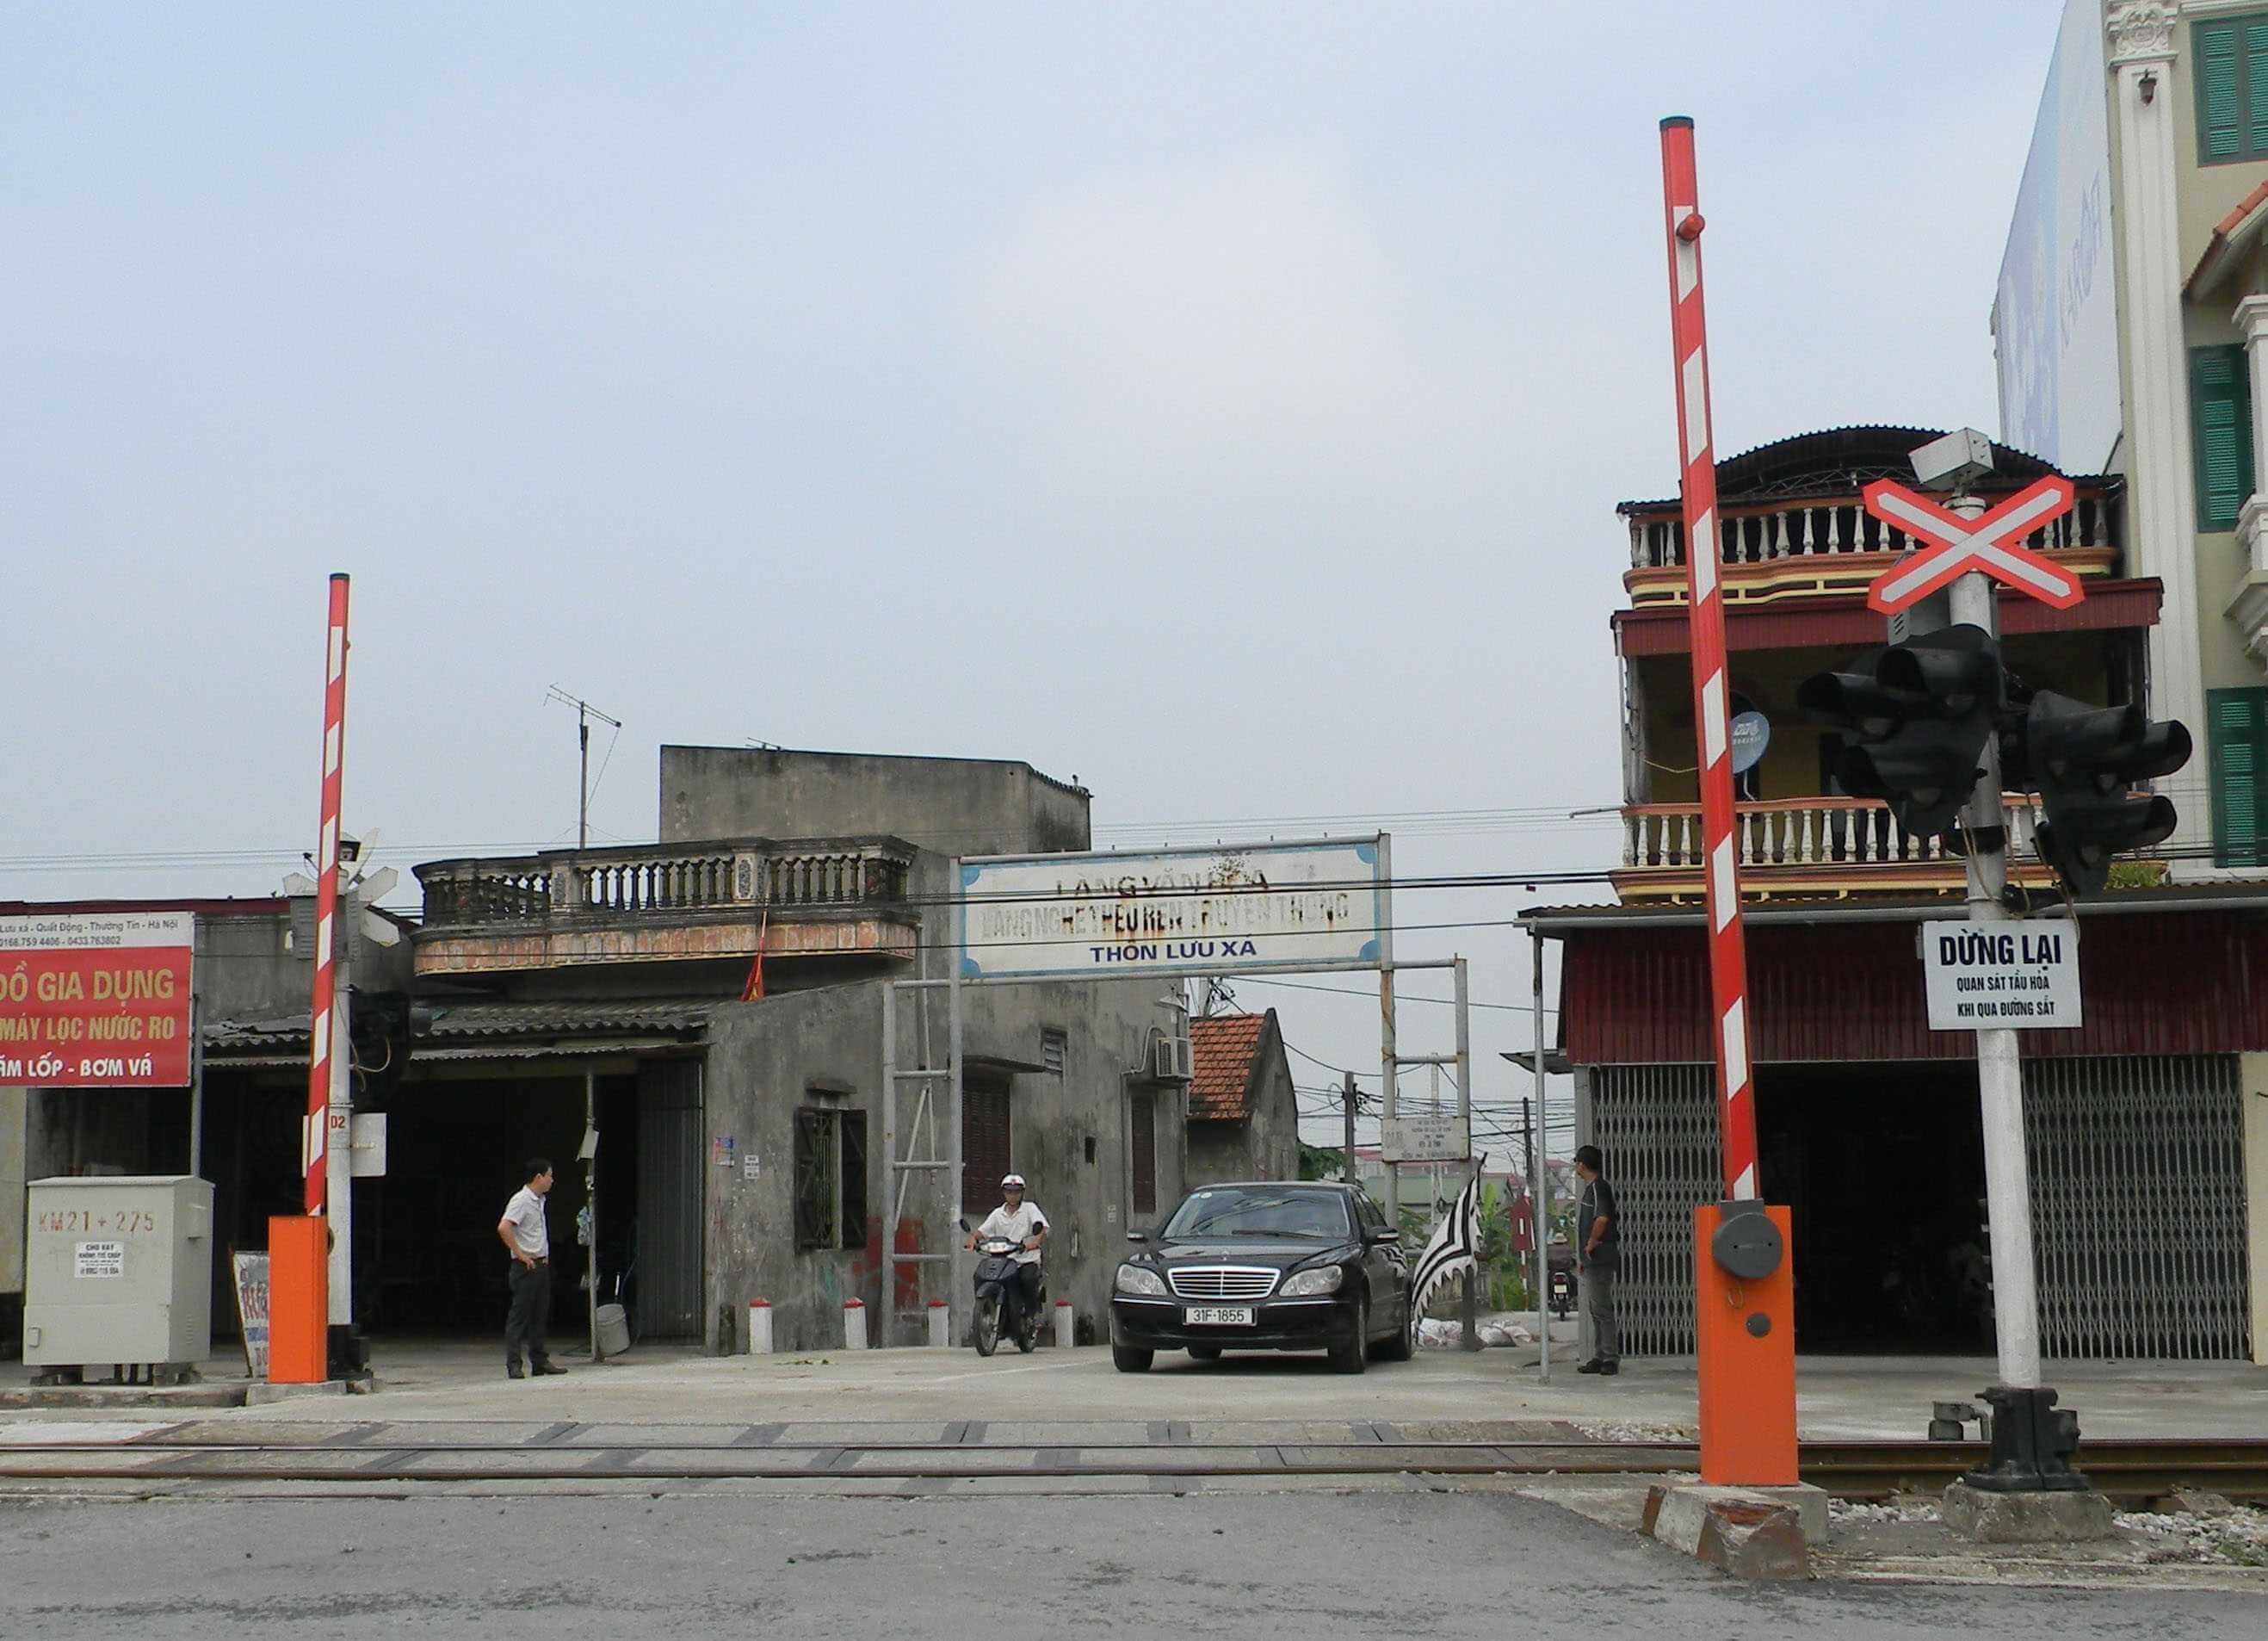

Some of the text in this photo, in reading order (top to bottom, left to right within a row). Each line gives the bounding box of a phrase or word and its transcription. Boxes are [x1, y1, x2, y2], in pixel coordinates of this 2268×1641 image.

[1090, 938, 1157, 963] THÔN
[1166, 939, 1214, 960] LƯU
[1939, 928, 2061, 971] DỪNG LẠI
[37, 971, 84, 1002] GIA
[93, 968, 175, 1007] DỤNG
[1956, 969, 2050, 993] QUAN SÁT TẦU HỎA
[1957, 994, 2055, 1018] KHI QUA ĐƯỜNG SẮT
[0, 1010, 176, 1045] MÁY LỌC NƯỚC RO
[28, 1051, 64, 1077] LỐP
[80, 1058, 124, 1077] BƠM
[128, 1052, 152, 1076] VÁ
[1193, 1309, 1245, 1322] 31F-1855
